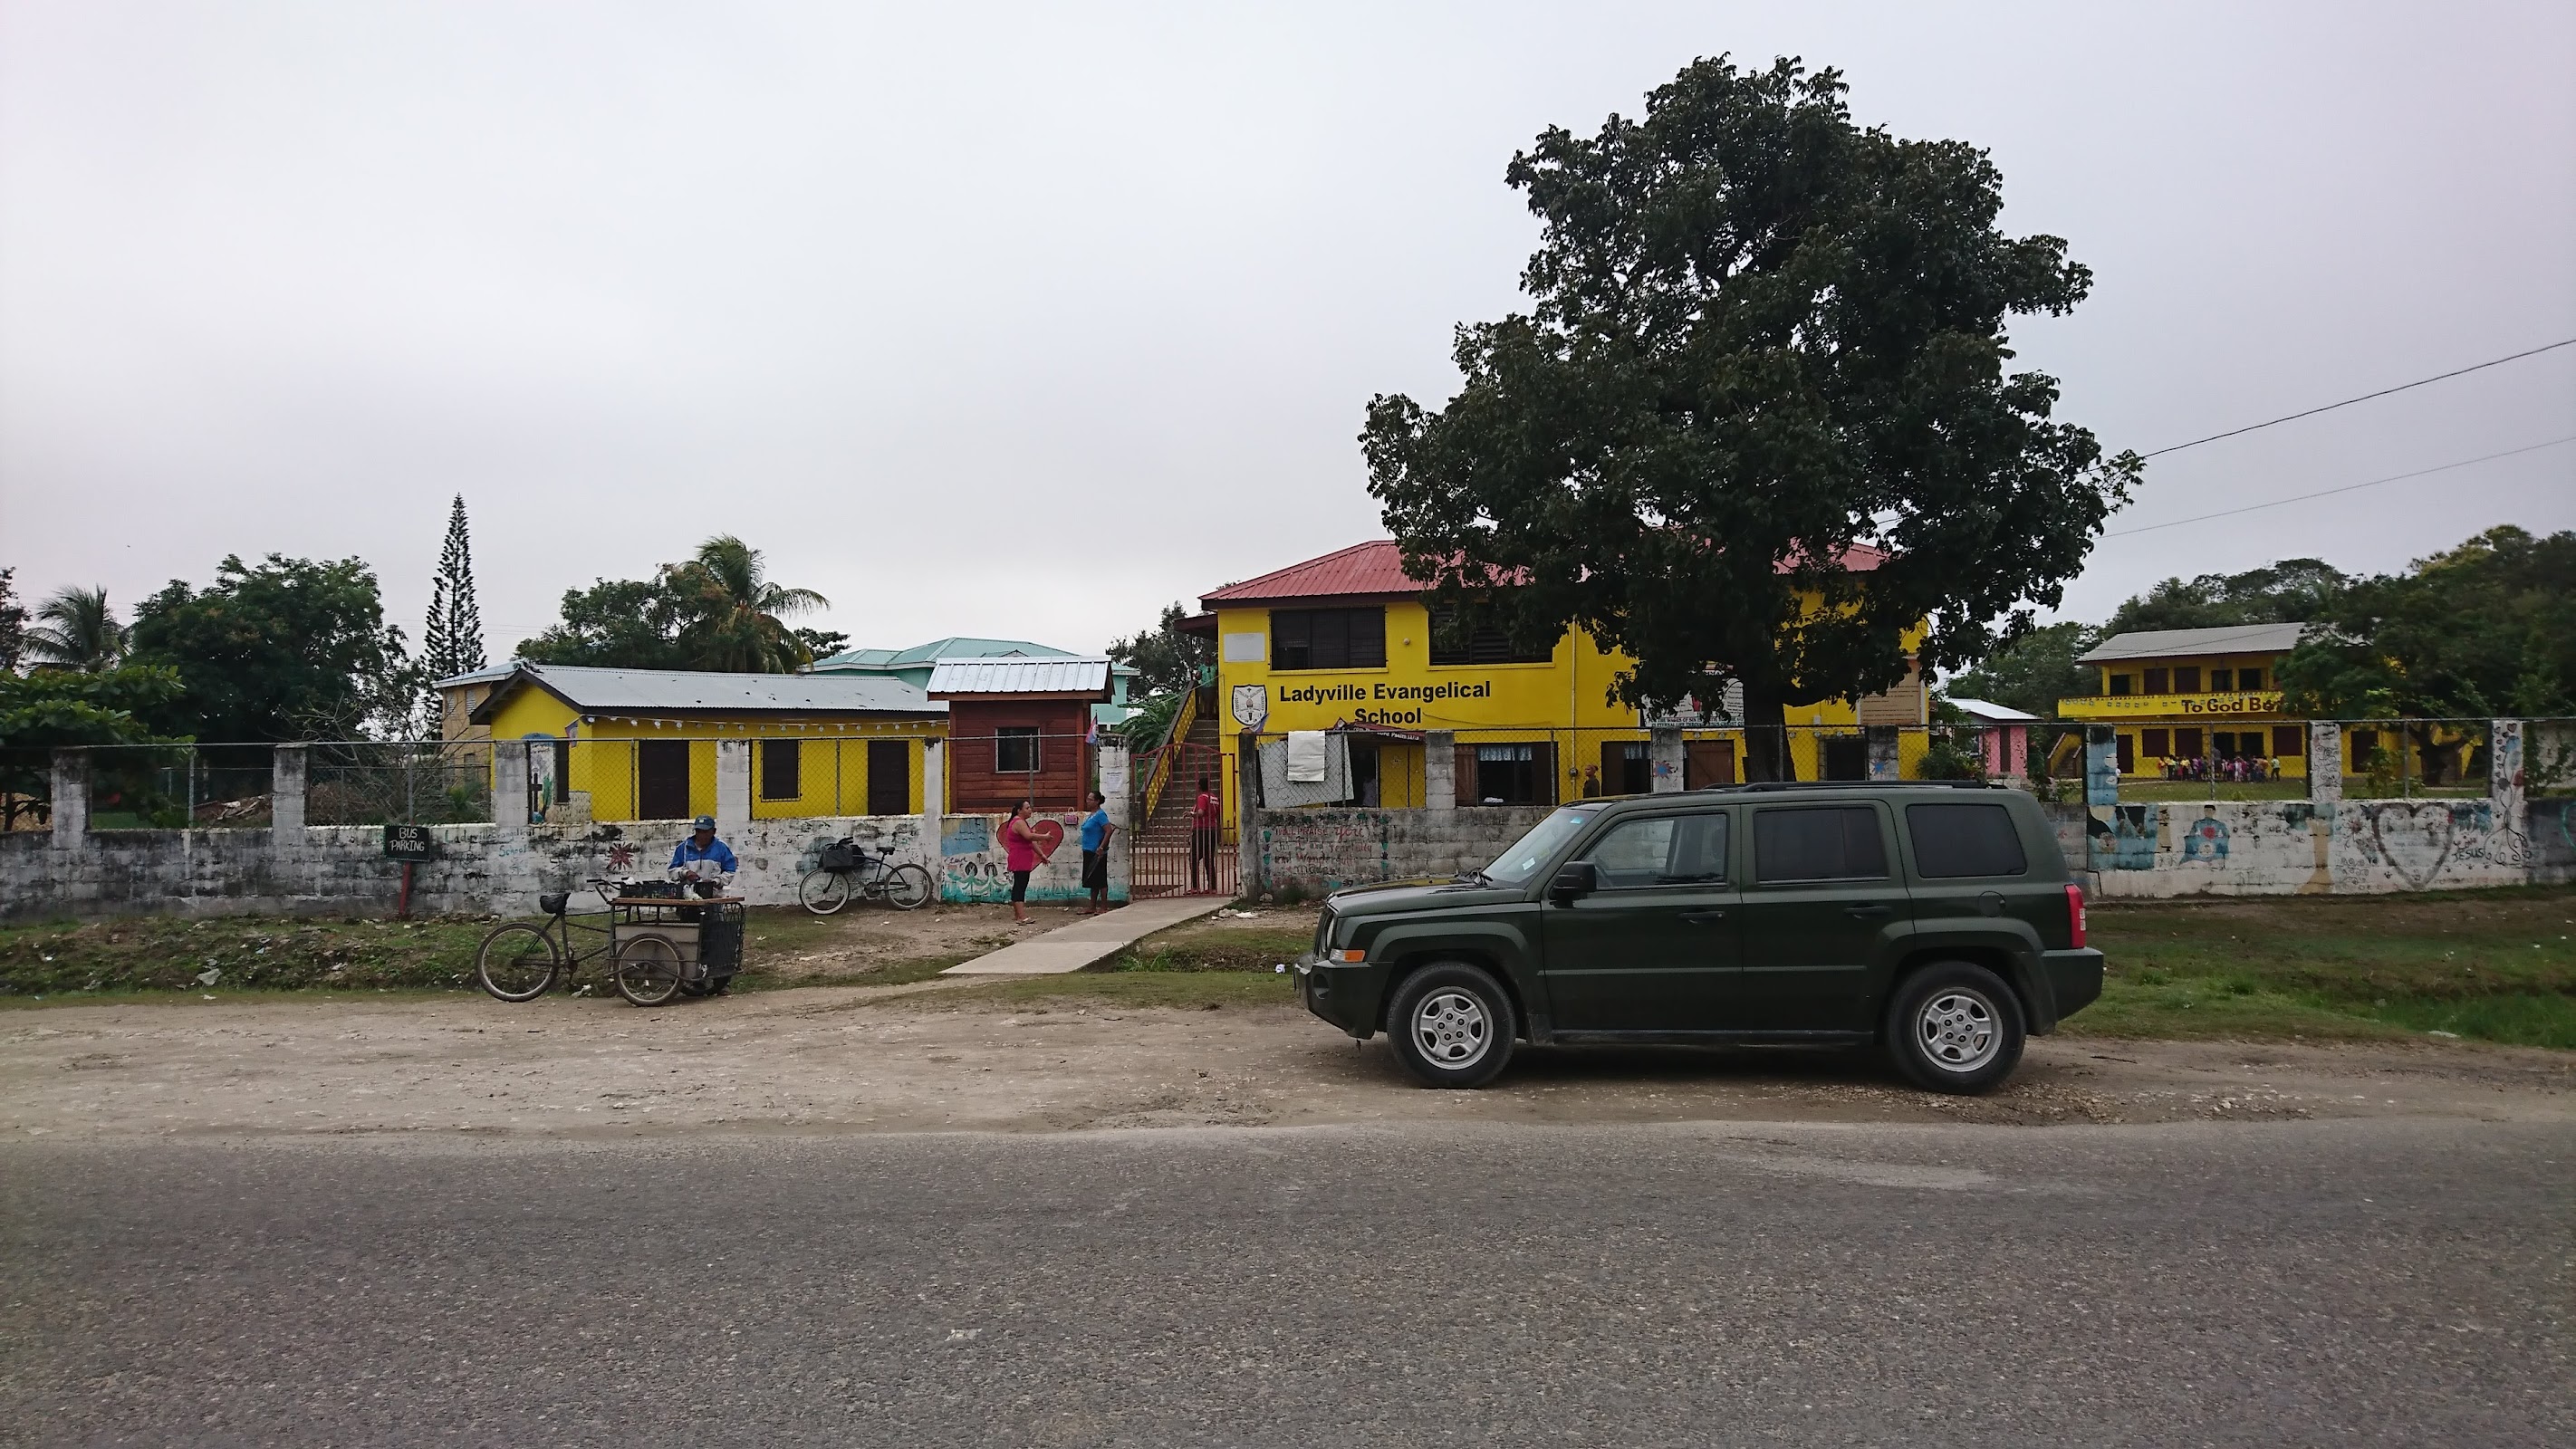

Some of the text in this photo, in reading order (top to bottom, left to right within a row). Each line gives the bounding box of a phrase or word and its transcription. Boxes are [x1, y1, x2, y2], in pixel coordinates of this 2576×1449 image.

[1279, 685, 1366, 705] Ladyville
[1373, 681, 1490, 704] Evangelical
[2181, 698, 2203, 714] To
[2206, 696, 2244, 713] God
[1354, 707, 1421, 724] School
[399, 827, 418, 840] BUS
[389, 840, 425, 852] PARKING
[2451, 847, 2485, 863] JESUS
